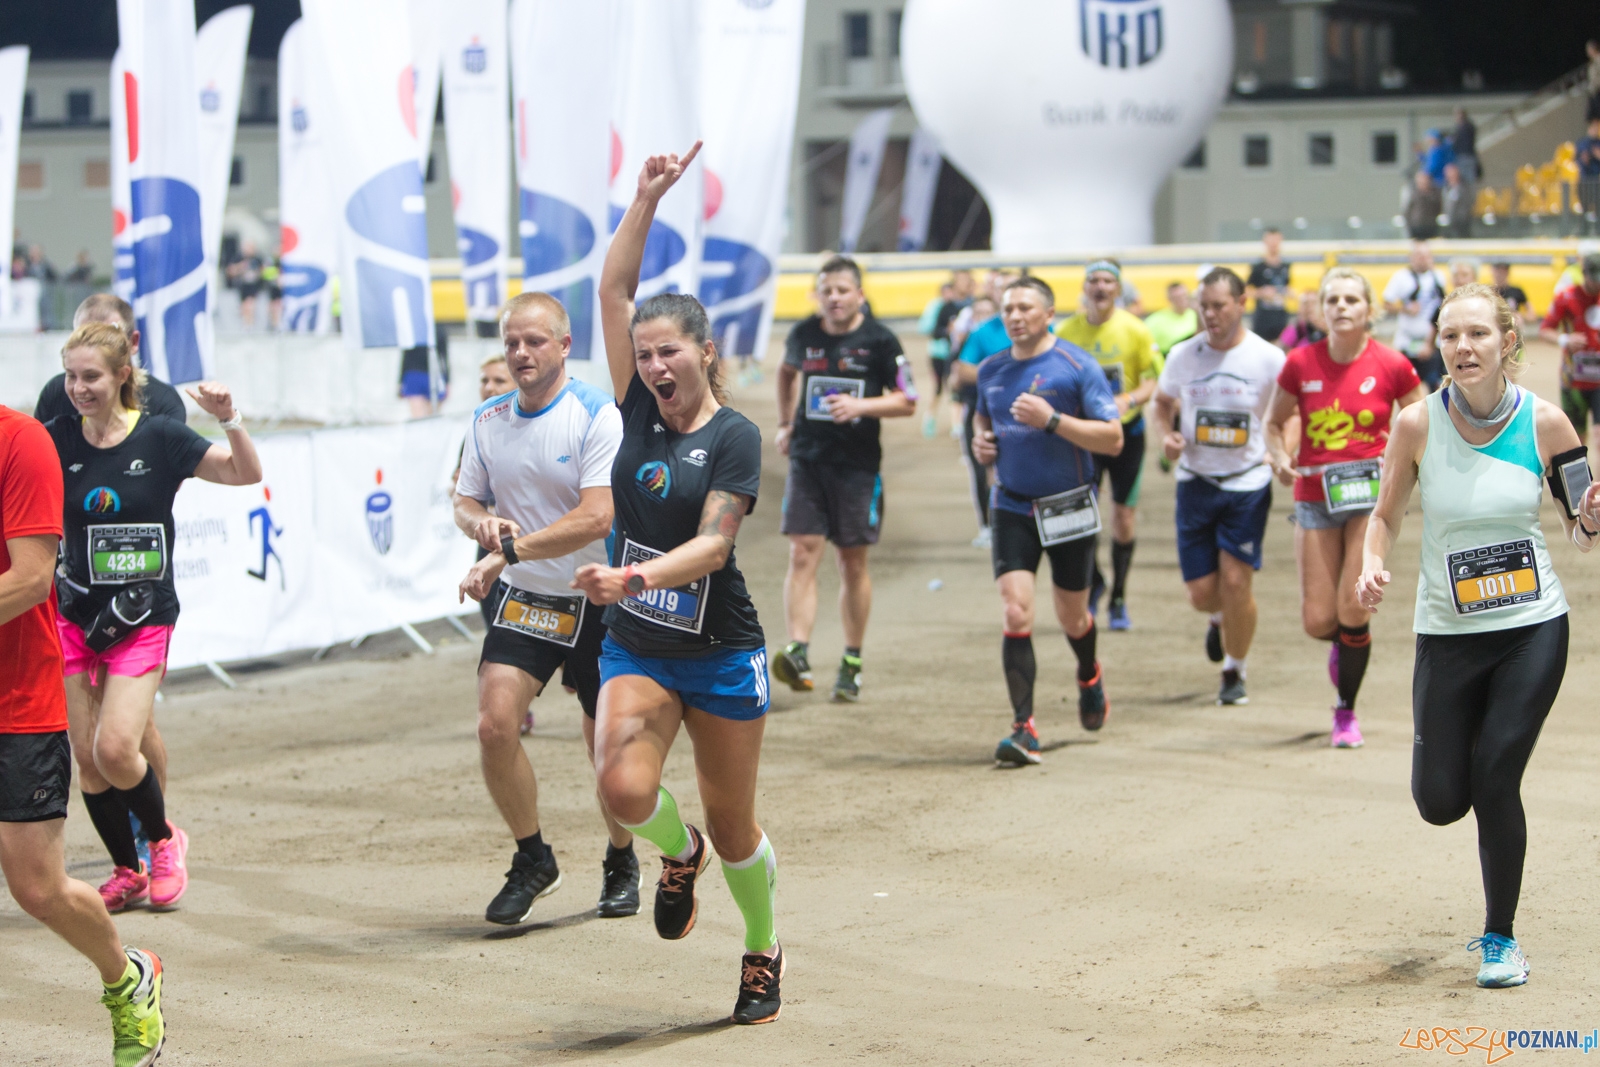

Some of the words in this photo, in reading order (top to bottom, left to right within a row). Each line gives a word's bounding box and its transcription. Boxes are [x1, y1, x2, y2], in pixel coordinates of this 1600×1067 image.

[107, 553, 147, 571] 4234
[1476, 573, 1516, 599] 1011
[520, 605, 560, 630] 7935
